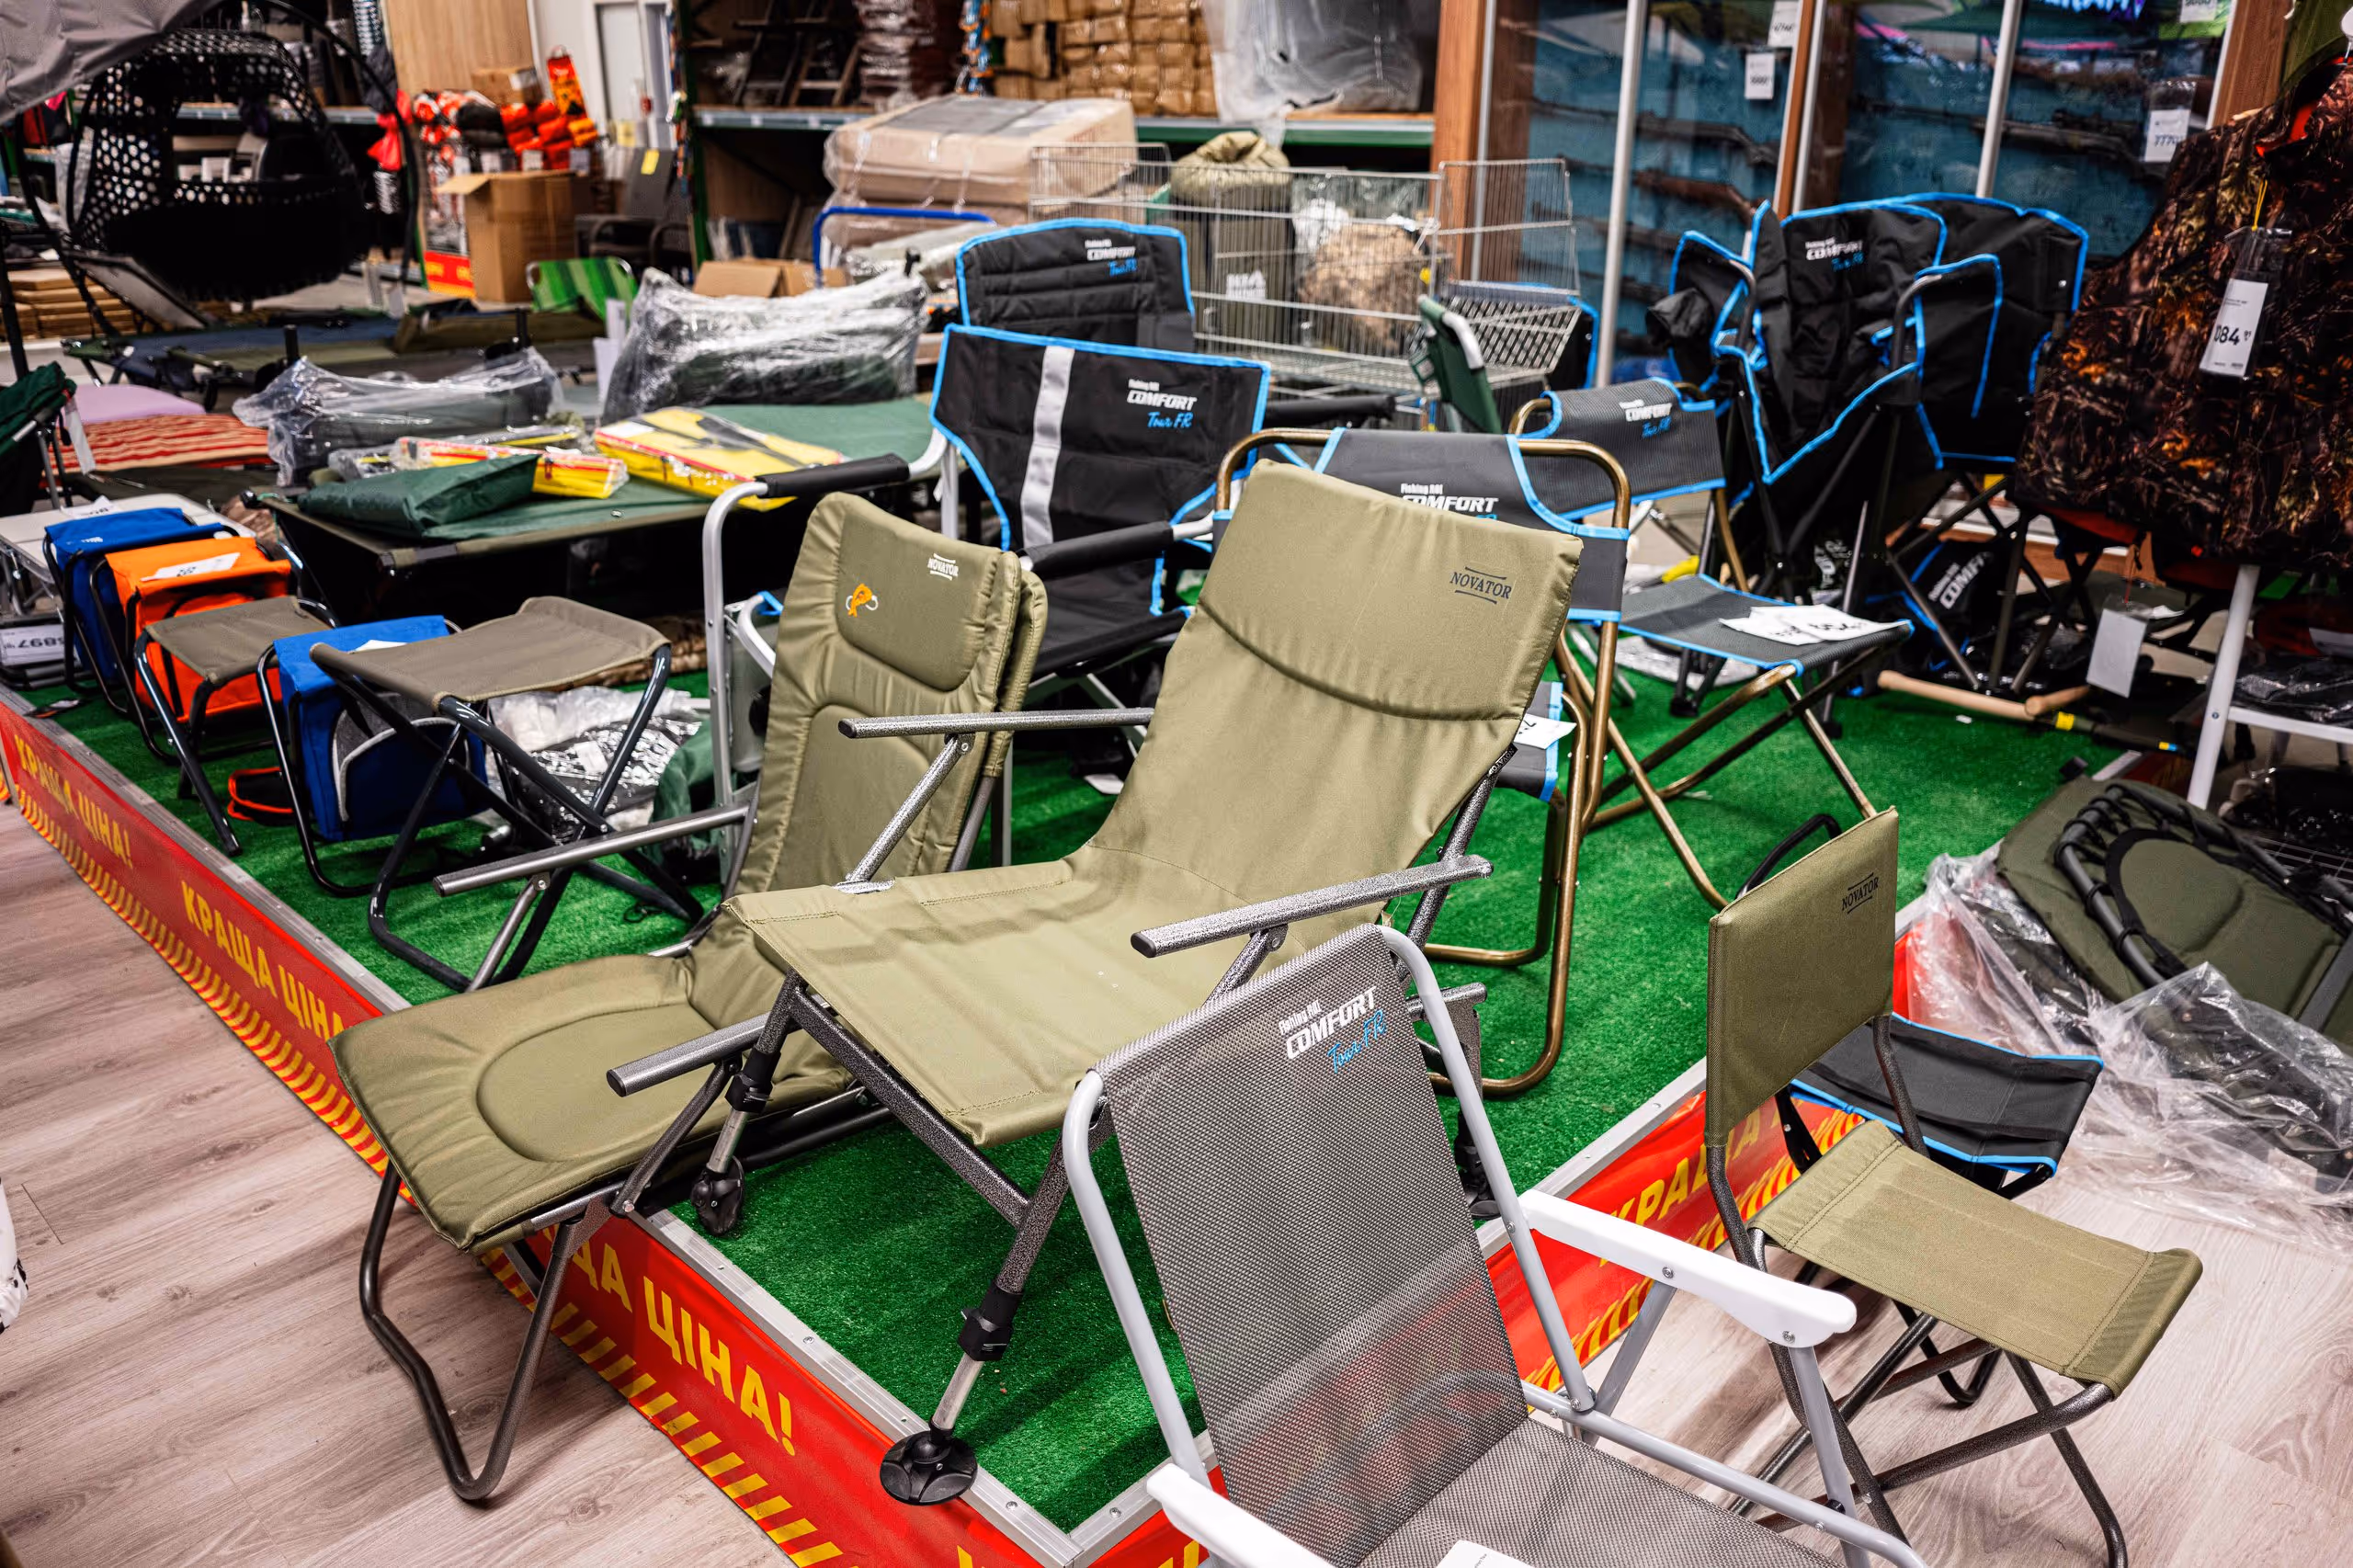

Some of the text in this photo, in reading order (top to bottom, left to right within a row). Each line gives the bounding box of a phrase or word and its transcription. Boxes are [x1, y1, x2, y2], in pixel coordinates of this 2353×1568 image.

[1127, 390, 1198, 411] COMFORT
[927, 557, 959, 577] NOVATOR
[1449, 572, 1512, 599] NOVATOR
[77, 790, 133, 869] ЦІНА!
[1842, 877, 1879, 911] NOVATOR
[181, 881, 278, 999] КРАЩА
[1286, 985, 1377, 1060] COMFORT
[1326, 1008, 1386, 1074] Tour FR
[643, 1276, 795, 1457] ЦІНА!
